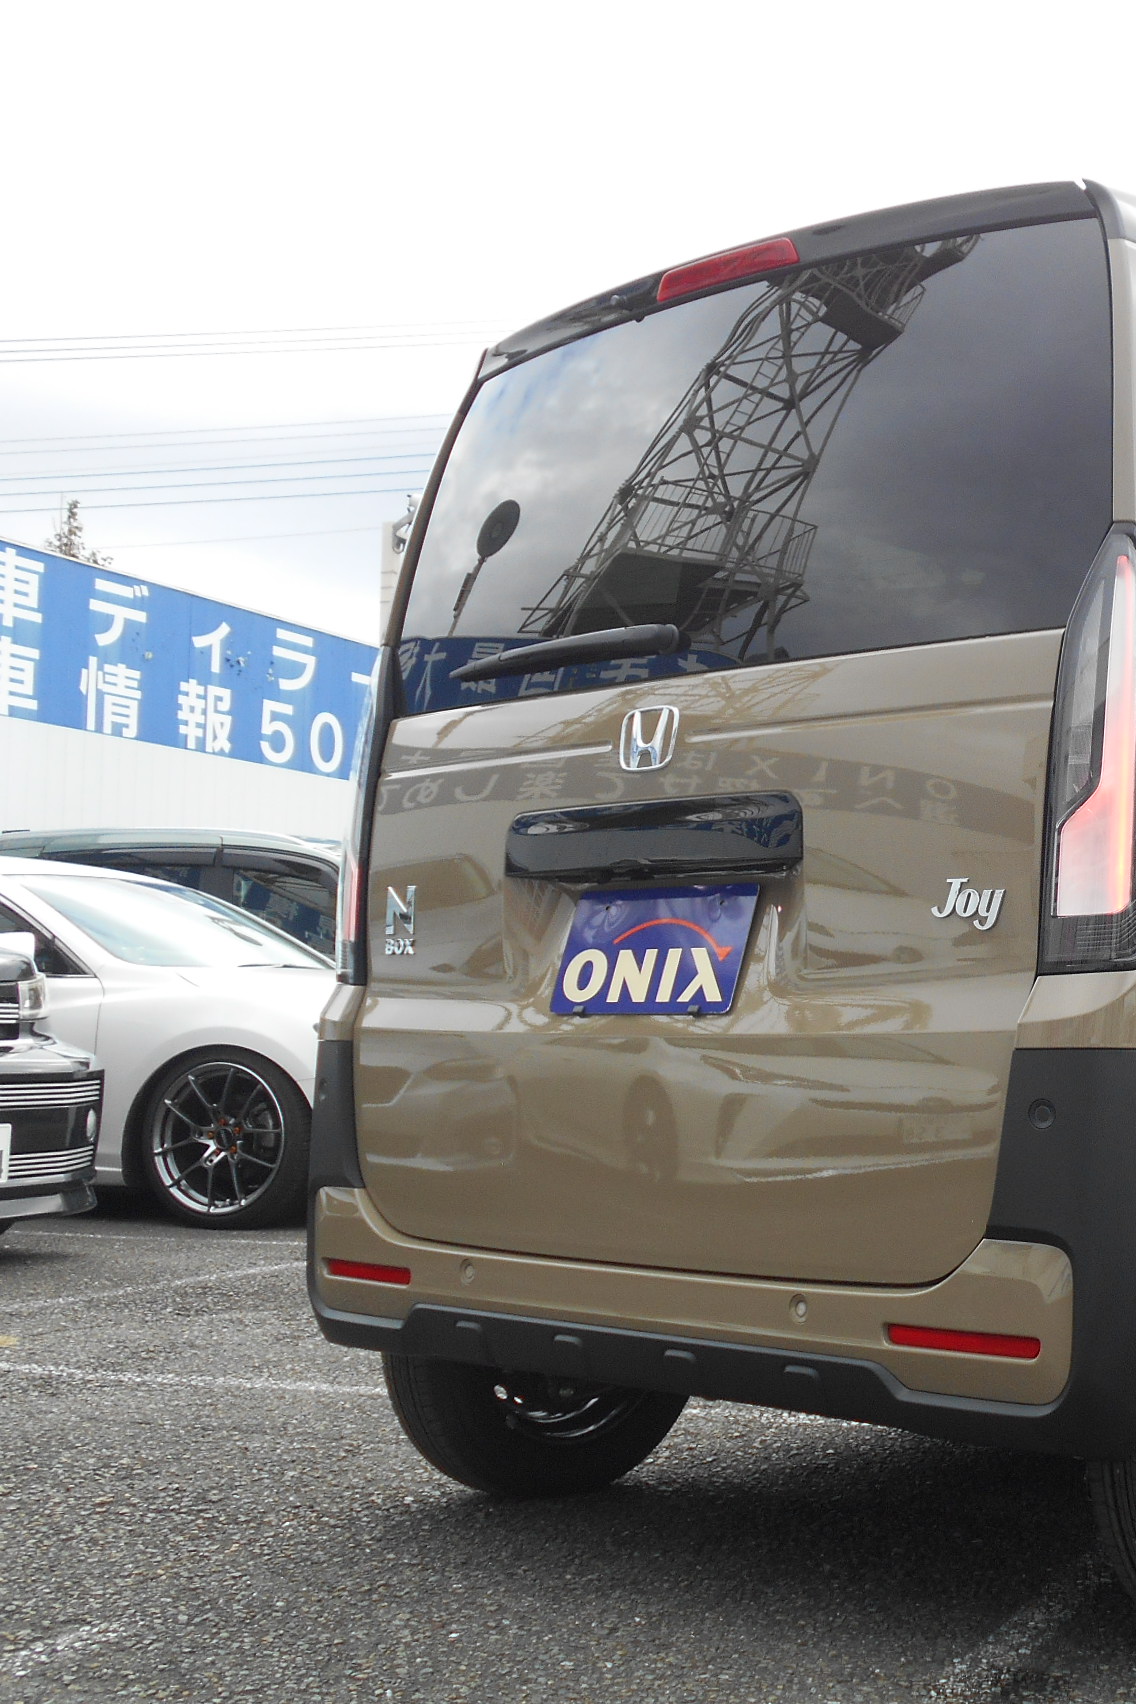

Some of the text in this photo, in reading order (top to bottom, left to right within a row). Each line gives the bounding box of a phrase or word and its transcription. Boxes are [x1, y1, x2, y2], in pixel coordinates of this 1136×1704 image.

[385, 886, 417, 935] N
[930, 877, 1005, 931] Joy
[385, 938, 415, 955] BOX
[562, 947, 723, 1003] ONIX
